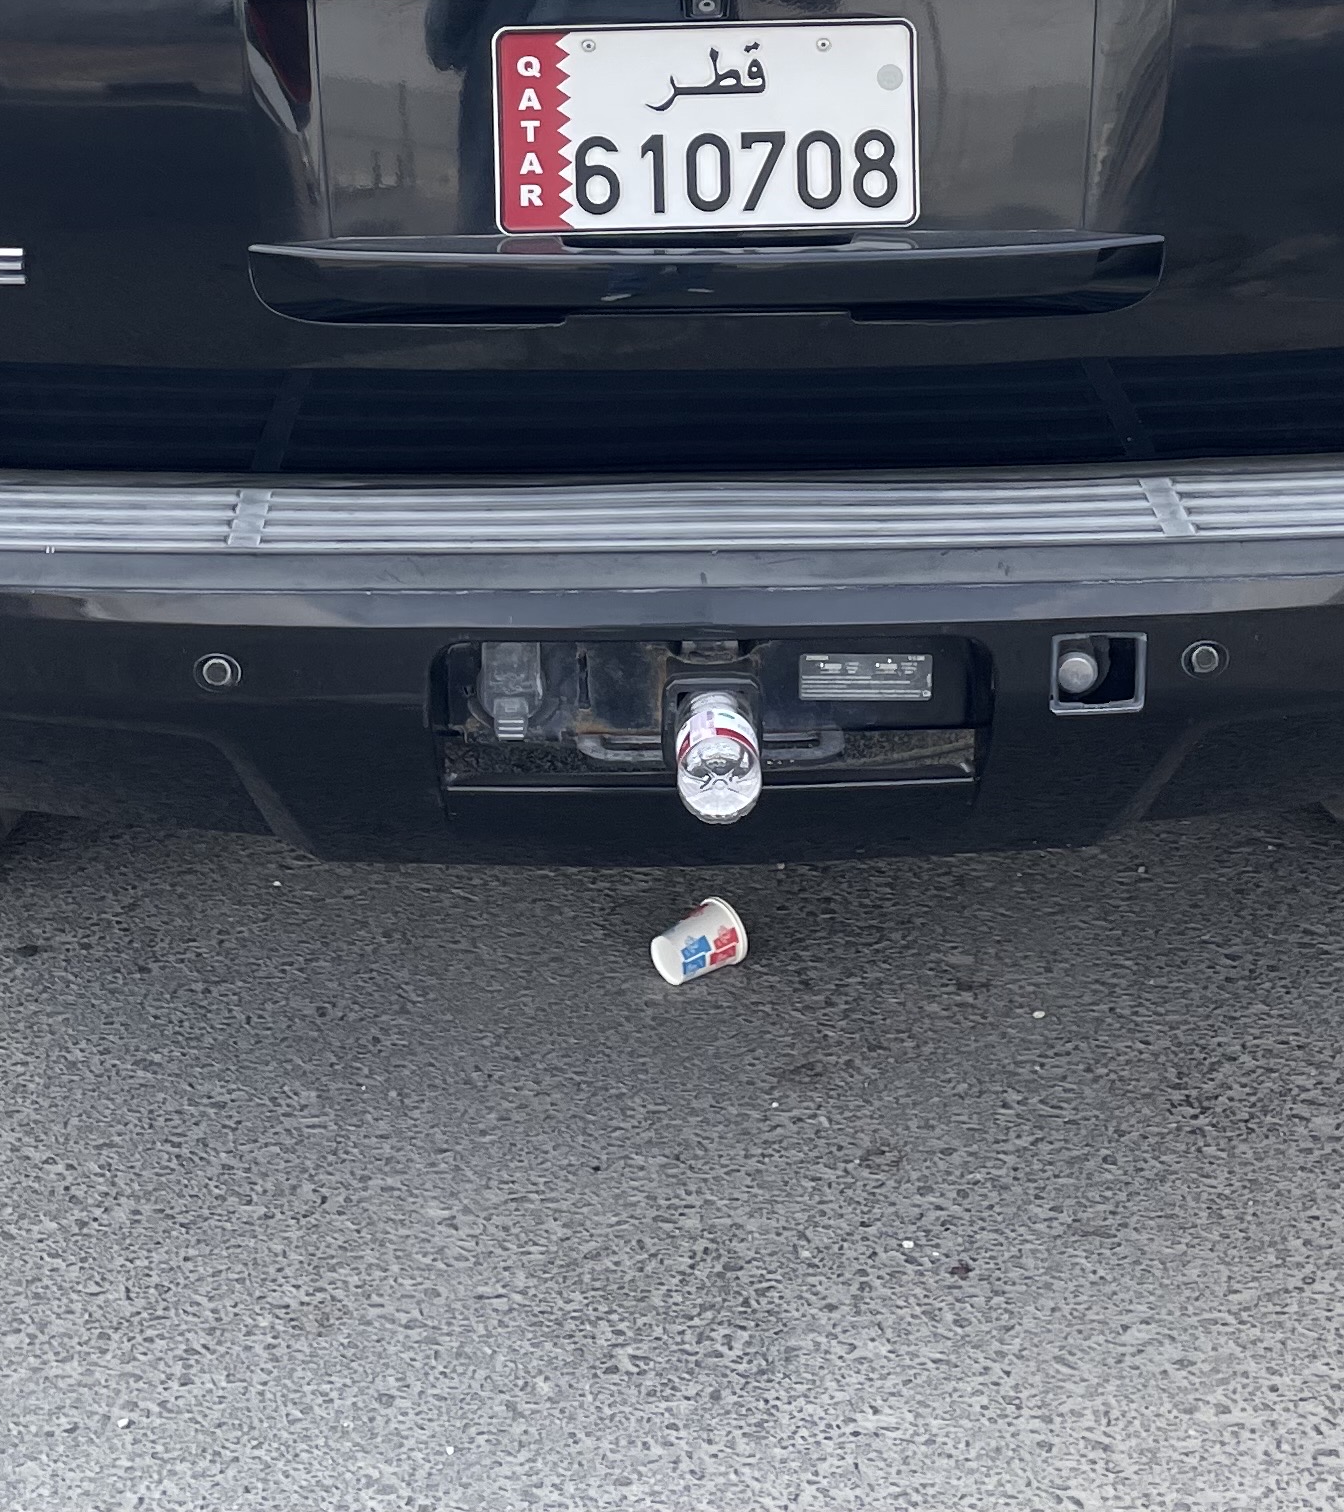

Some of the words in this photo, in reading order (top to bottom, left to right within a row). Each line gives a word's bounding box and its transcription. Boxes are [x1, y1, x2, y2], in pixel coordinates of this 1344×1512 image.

[645, 42, 767, 112] قطر
[516, 56, 544, 207] QATAR
[574, 129, 898, 215] 610708
